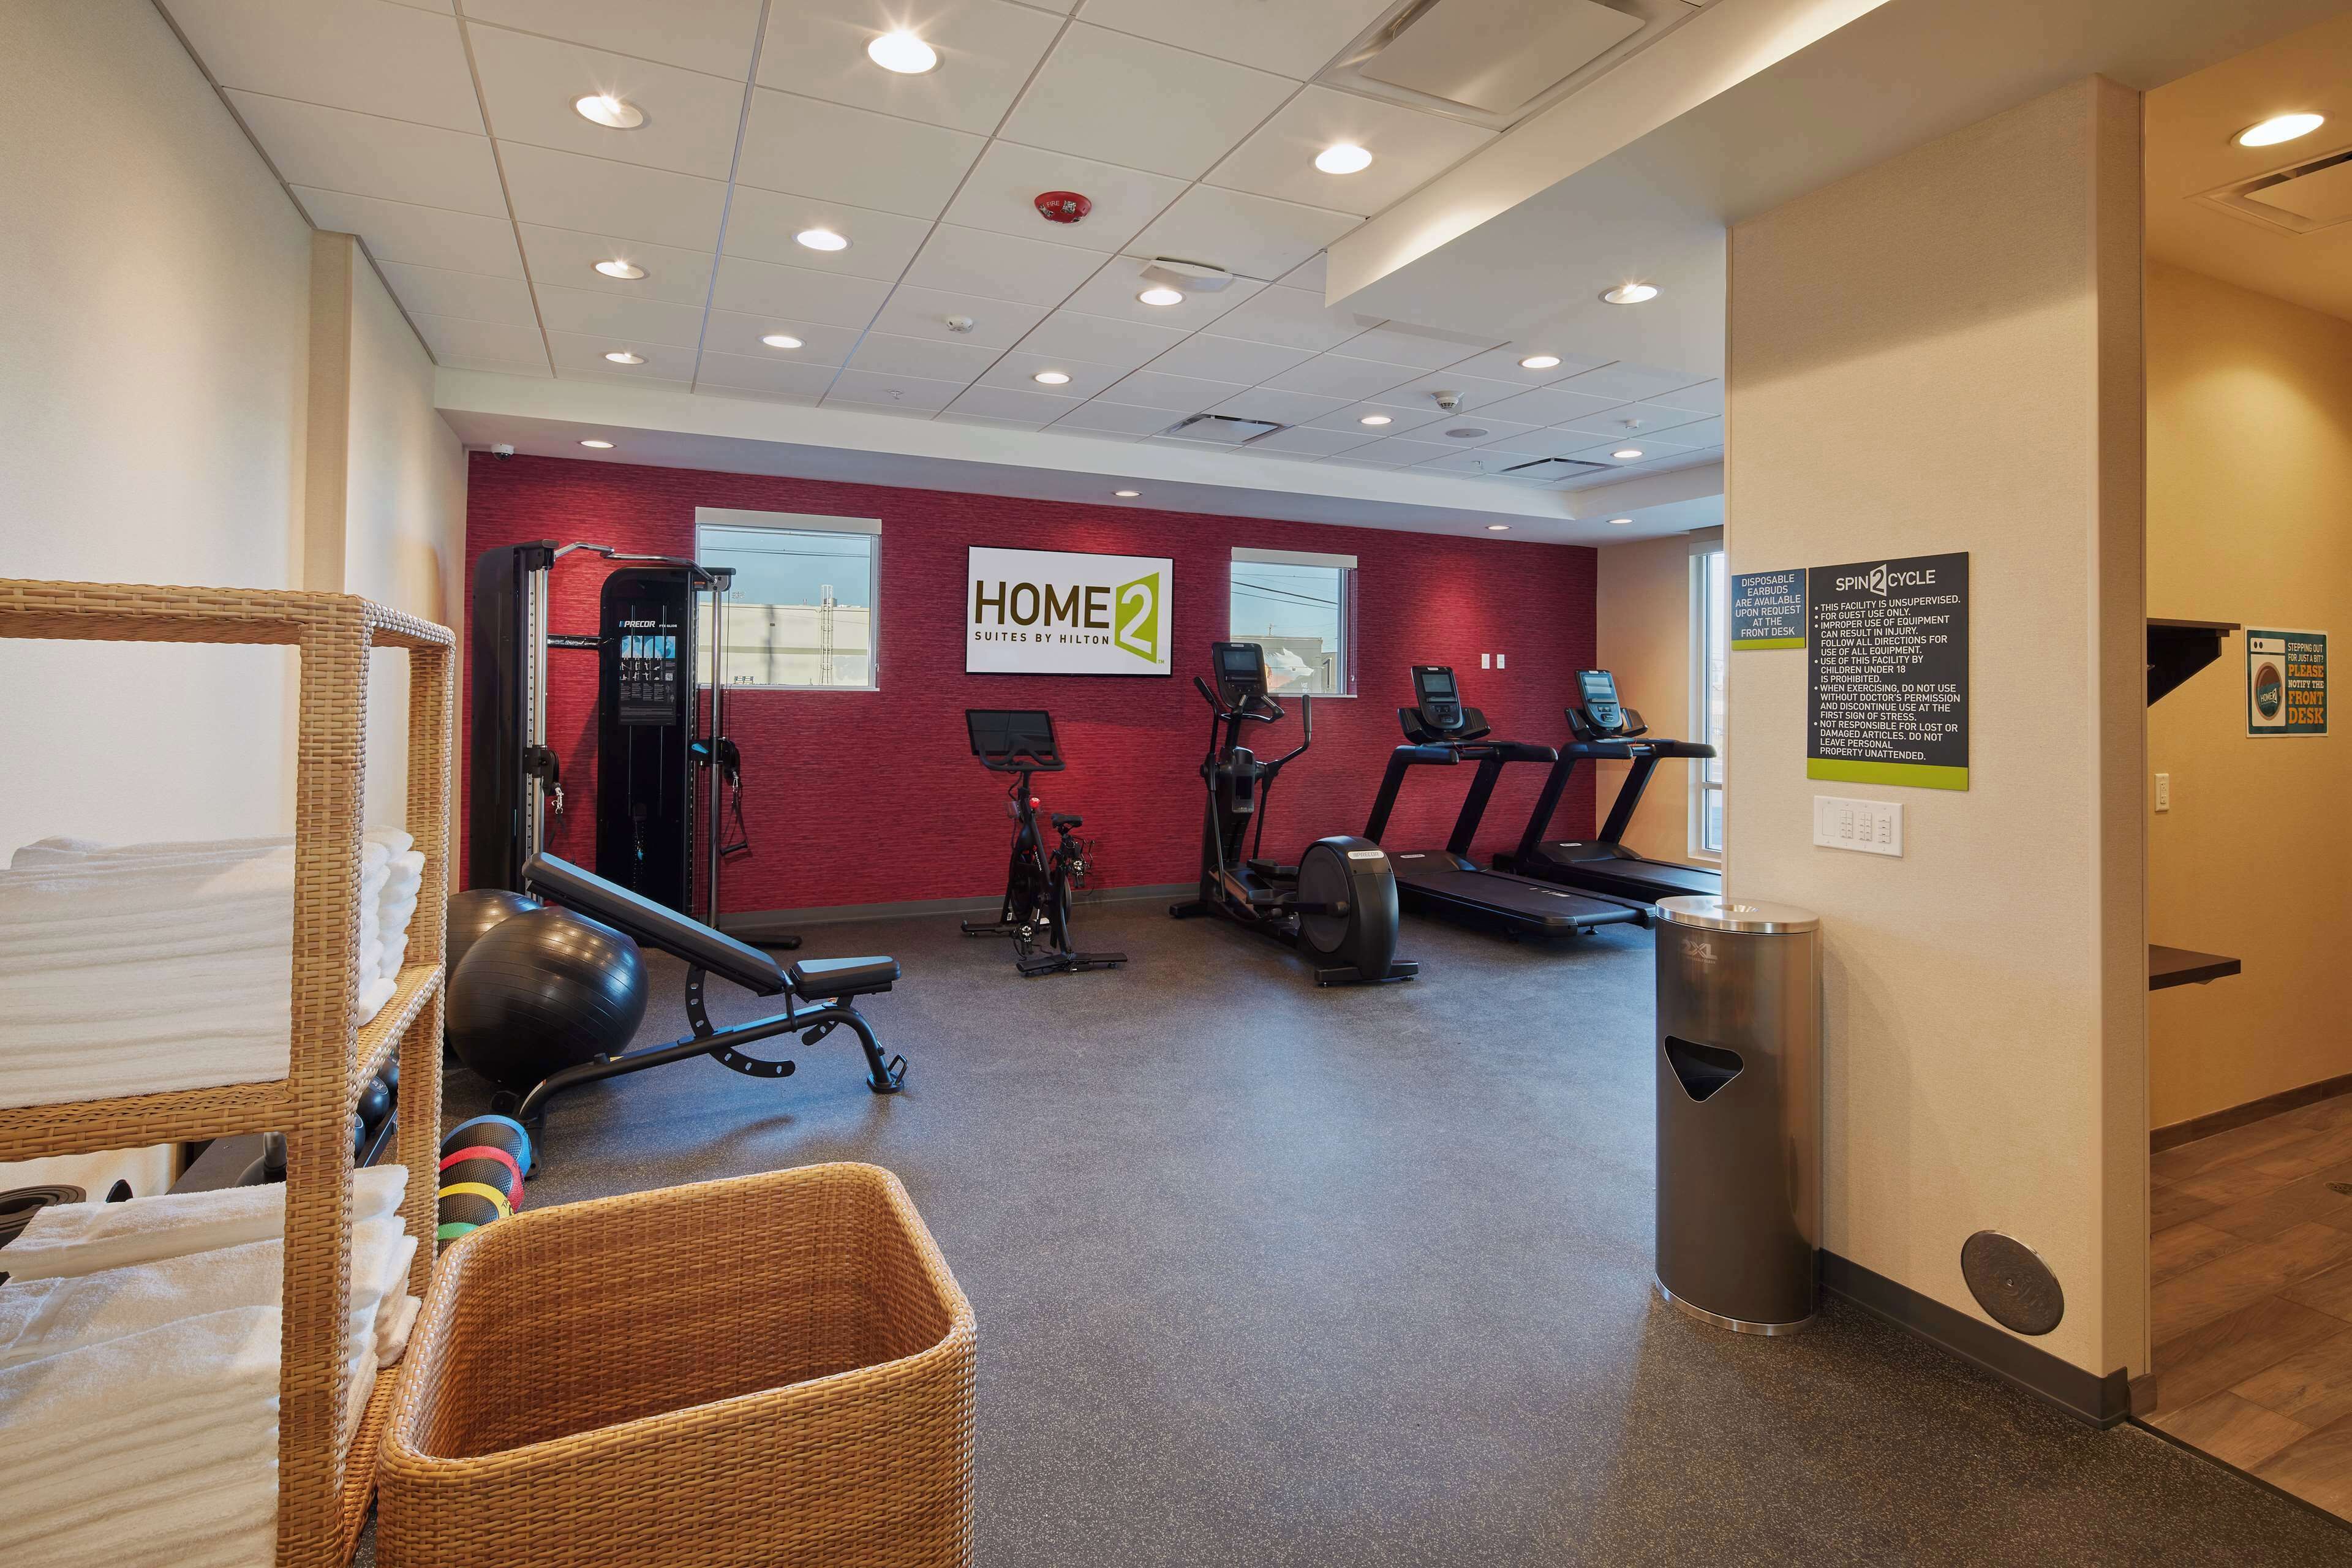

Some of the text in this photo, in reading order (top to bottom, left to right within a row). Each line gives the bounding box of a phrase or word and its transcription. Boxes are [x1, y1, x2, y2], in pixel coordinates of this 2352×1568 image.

[1741, 573, 1794, 587] DISPOSABLE
[1836, 576, 1869, 591] SPIN
[1888, 570, 1936, 587] CYCLE
[1747, 584, 1788, 596] EARBUDS
[1735, 594, 1801, 607] ARE AVAILABLE
[1820, 594, 1961, 611] THIS FACILITY IS UNSUPERVISED.
[974, 580, 1153, 654] HOME 2
[1735, 605, 1801, 617] UPON REQUEST
[1838, 610, 1866, 619] GUEST
[1868, 609, 1884, 617] USE
[1887, 607, 1910, 617] ONLY.
[1752, 616, 1782, 627] AT THE
[1820, 615, 1950, 629] IMPROPER USE OF EQUIPMENT
[974, 631, 1109, 644] SUITES BY HILTON
[1741, 626, 1795, 637] FRONT DESK
[1840, 628, 1872, 637] RESULT
[1885, 626, 1918, 635] INJURY.
[1821, 638, 1854, 647] FOLLOW
[1874, 635, 1926, 645] DIRECTIONS
[1929, 635, 1947, 643] FOR
[1820, 647, 1837, 656] USE
[1869, 645, 1922, 655] EQUIPMENT.
[2288, 643, 2312, 652] STEPPING
[1872, 655, 1910, 664] FACILITY
[1912, 655, 1923, 663] BY
[2288, 653, 2297, 662] FOR
[2298, 654, 2310, 662] JUST
[1820, 665, 1861, 674] CHILDREN
[1864, 665, 1893, 673] UNDER
[2288, 665, 2323, 677] PLEASE
[1847, 684, 1899, 693] EXERCISING,
[1901, 684, 1914, 692] DO
[1917, 684, 1936, 692] NOT
[1937, 684, 1956, 692] USE
[1904, 693, 1960, 702] PERMISSION
[2260, 692, 2273, 703] HOME
[2288, 691, 2324, 704] FRONT
[1839, 702, 1896, 710] DISCONTINUE
[1899, 703, 1916, 711] USE
[1931, 703, 1950, 712] THE
[1880, 712, 1917, 721] STRESS.
[2289, 707, 2323, 724] DESK
[1838, 720, 1896, 730] RESPONSIBLE
[1899, 722, 1917, 731] FOR
[1919, 722, 1942, 731] LOST
[1945, 723, 1958, 732] OR
[1820, 728, 1860, 737] DAMAGED
[1861, 730, 1906, 740] ARTICLES.
[1924, 733, 1943, 741] NOT
[1820, 737, 1893, 748] LEAVE PERSONAL
[1820, 747, 1926, 760] PROPERTY UNATTENDED.
